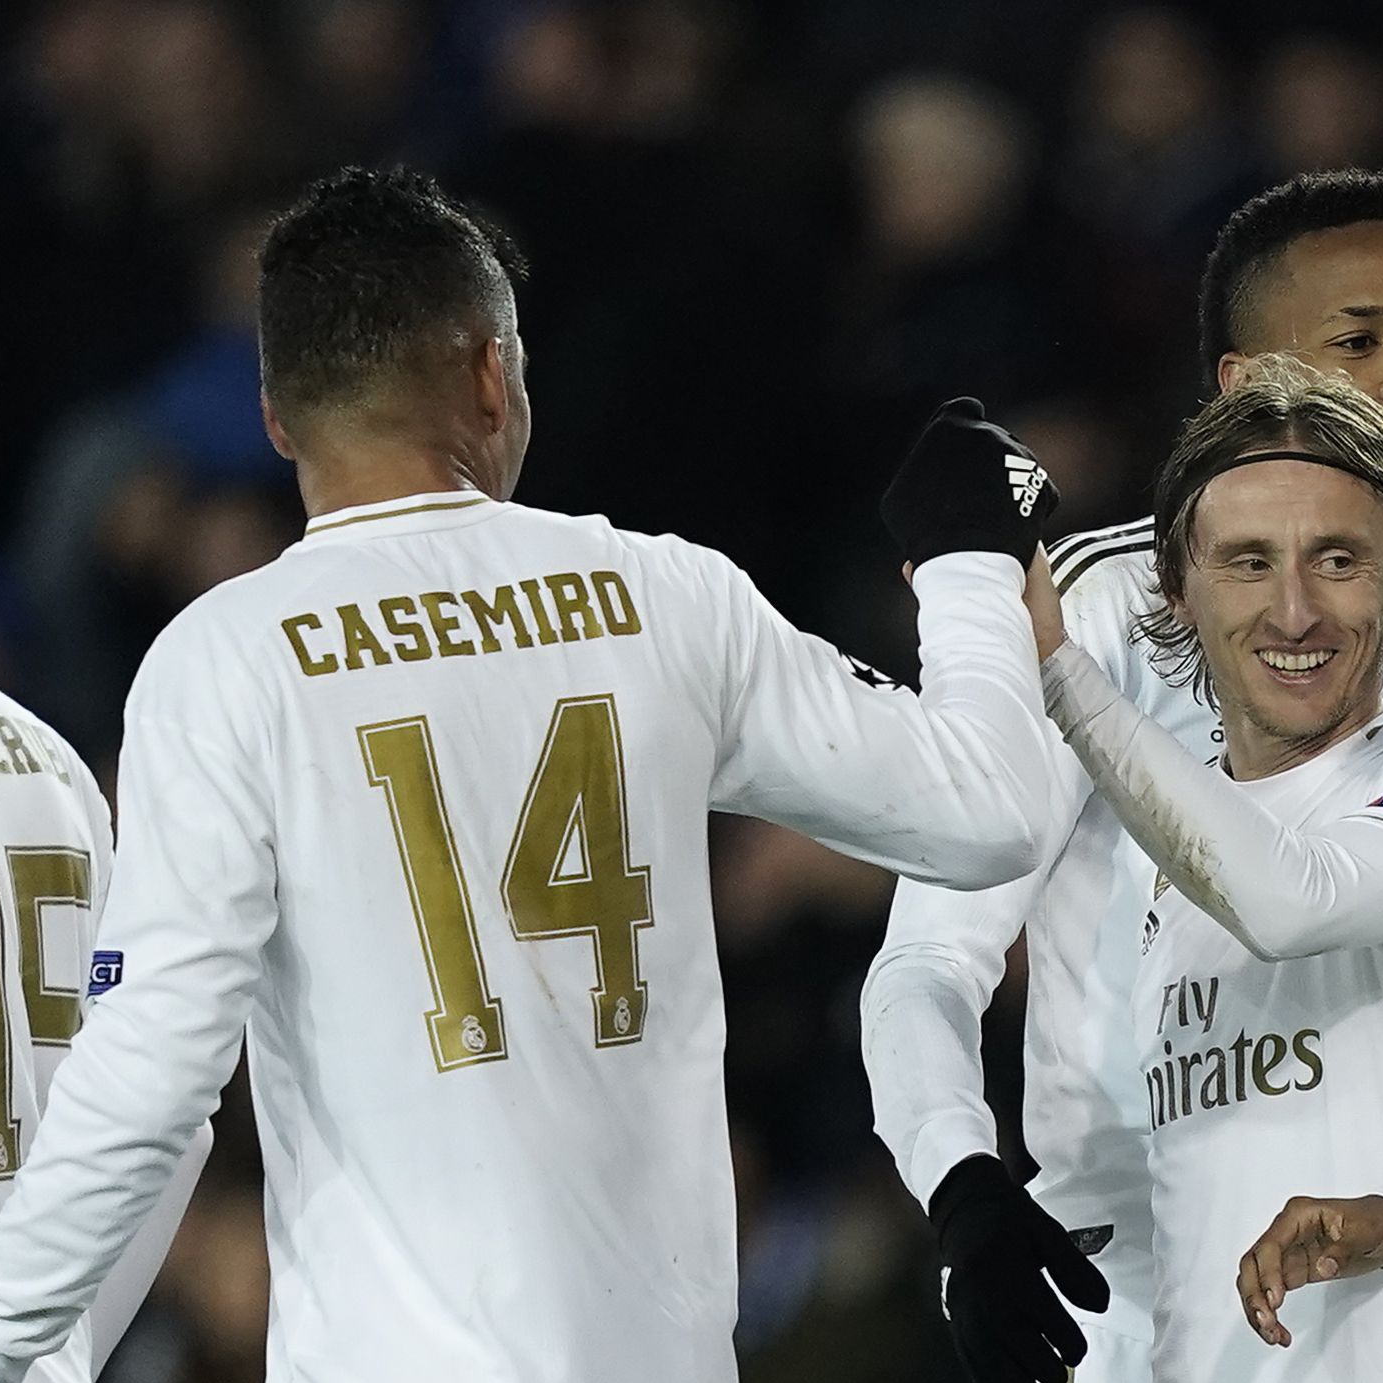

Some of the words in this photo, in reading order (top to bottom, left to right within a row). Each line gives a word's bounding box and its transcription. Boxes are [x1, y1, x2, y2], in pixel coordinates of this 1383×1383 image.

[281, 570, 642, 676] CASEMIRO
[356, 693, 654, 1073] 14
[1157, 975, 1219, 1035] Fly
